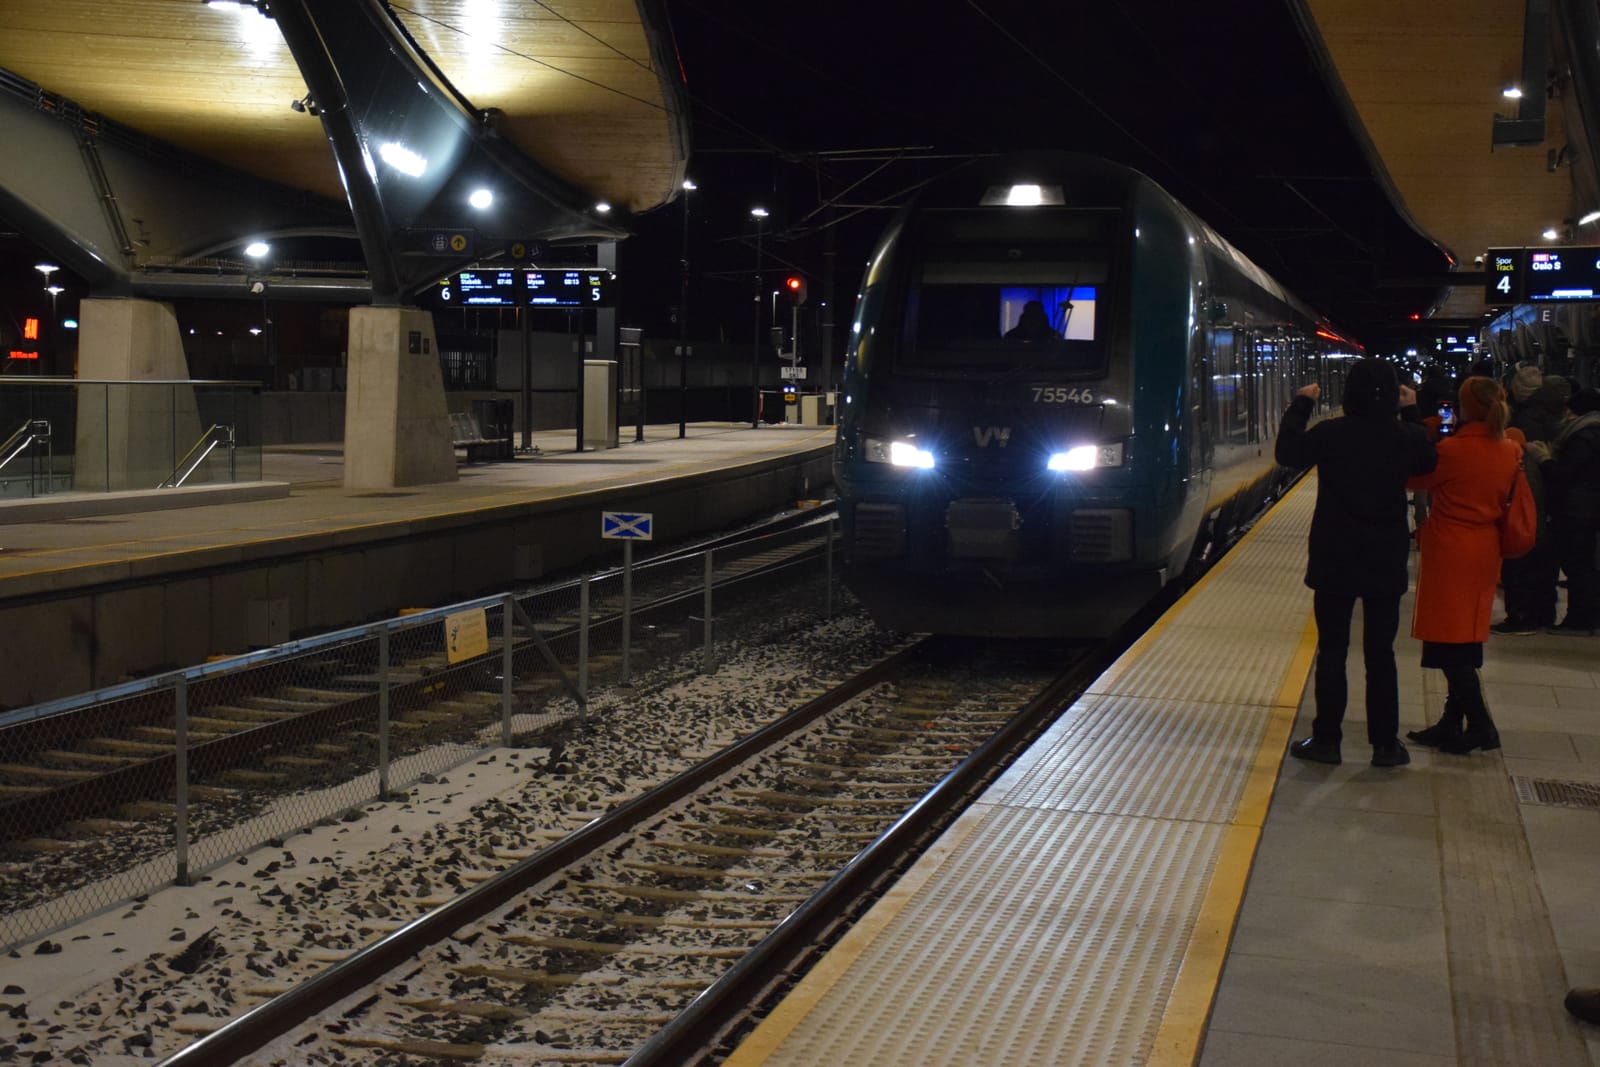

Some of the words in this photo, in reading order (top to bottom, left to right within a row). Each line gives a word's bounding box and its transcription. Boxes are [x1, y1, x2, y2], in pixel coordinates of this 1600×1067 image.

[1496, 257, 1512, 265] Spor
[1532, 261, 1553, 271] Oslo
[1554, 261, 1561, 270] S
[1496, 275, 1511, 294] 4
[441, 287, 451, 301] 6
[592, 287, 601, 301] 5
[1542, 310, 1551, 322] E
[1031, 387, 1093, 404] 75546
